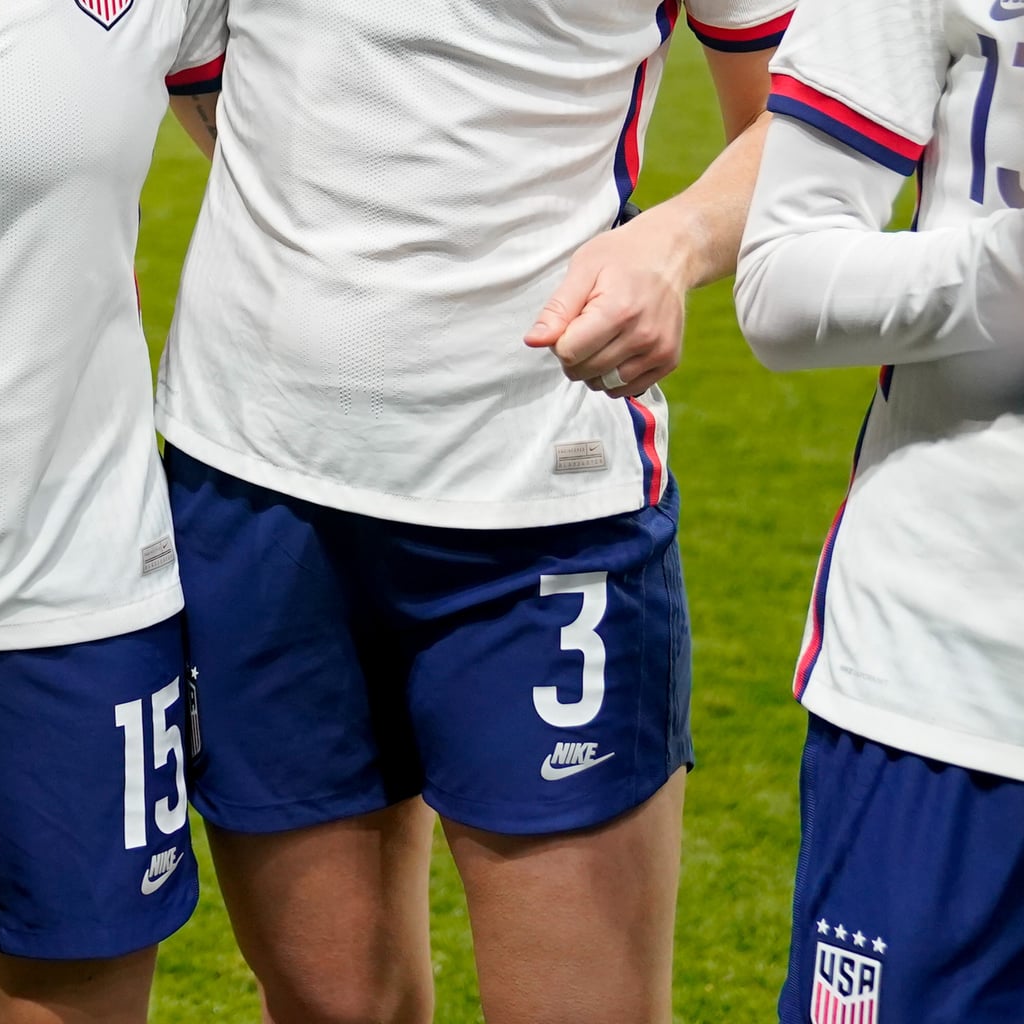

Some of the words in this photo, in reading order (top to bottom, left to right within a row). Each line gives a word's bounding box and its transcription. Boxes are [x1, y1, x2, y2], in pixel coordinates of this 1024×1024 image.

[532, 571, 609, 728] 3
[114, 676, 189, 850] 15
[551, 742, 599, 765] NIKE
[149, 846, 177, 878] NIKE
[819, 949, 876, 997] USA
